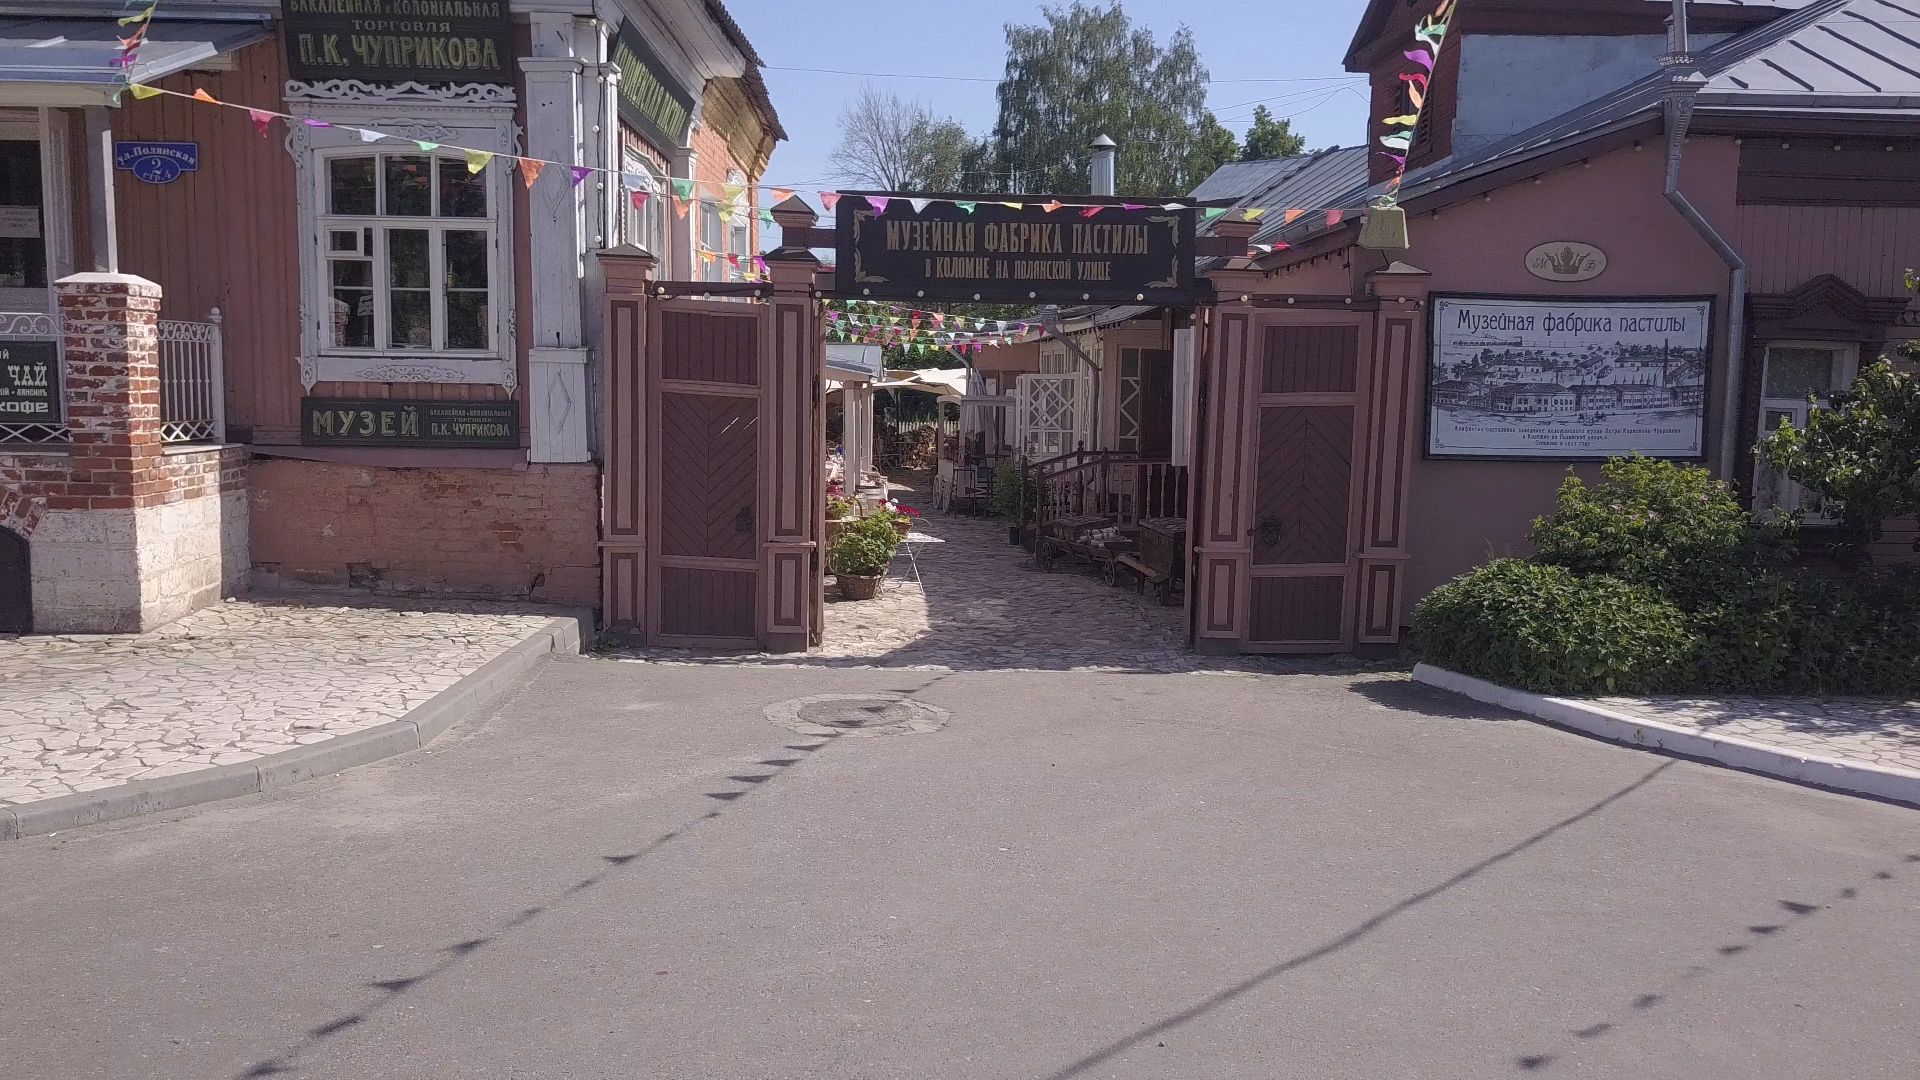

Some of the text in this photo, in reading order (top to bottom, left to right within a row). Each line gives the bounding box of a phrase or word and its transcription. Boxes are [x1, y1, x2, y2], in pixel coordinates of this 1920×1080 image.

[351, 19, 451, 32] ТОРГОВЛЯ
[298, 33, 500, 70] П.К. ЧУПРИКОВА
[151, 158, 162, 175] 2
[886, 218, 1149, 255] МУЗЕЙНАЯ ФАБРИКА ПАСТИЛЫ
[925, 256, 1112, 281] В КОЛОМНЕ НА ПОЛЯНСКОЙ УЛИЦЕ
[1457, 309, 1686, 337] Музейная фабрика пастилы
[8, 361, 48, 387] ЧАЙ
[312, 405, 420, 437] МУЗЕЙ
[431, 422, 511, 437] П.К. ЧУПРИКОВА
